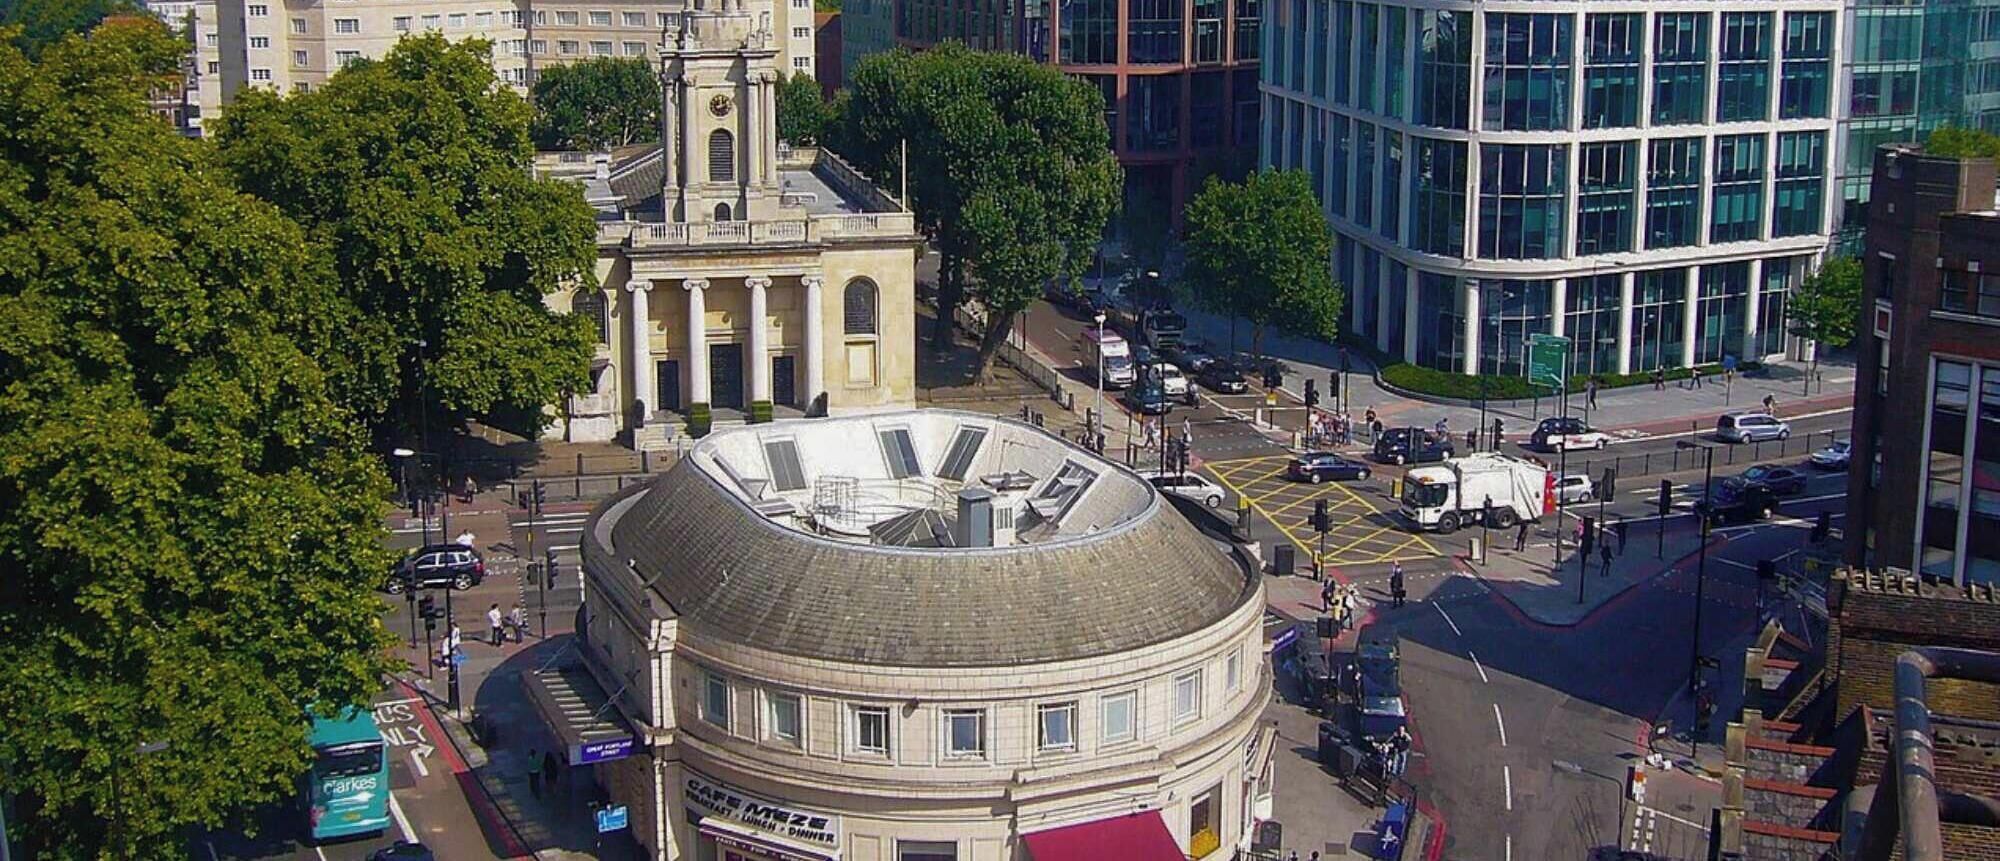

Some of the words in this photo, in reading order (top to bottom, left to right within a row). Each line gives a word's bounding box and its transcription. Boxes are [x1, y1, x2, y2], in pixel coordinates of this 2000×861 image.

[378, 724, 427, 747] NLY
[323, 776, 377, 795] clarkes
[687, 779, 742, 808] CAFE
[744, 802, 829, 830] MEZE
[741, 814, 776, 832] LUNCH
[788, 826, 835, 844] DINNER
